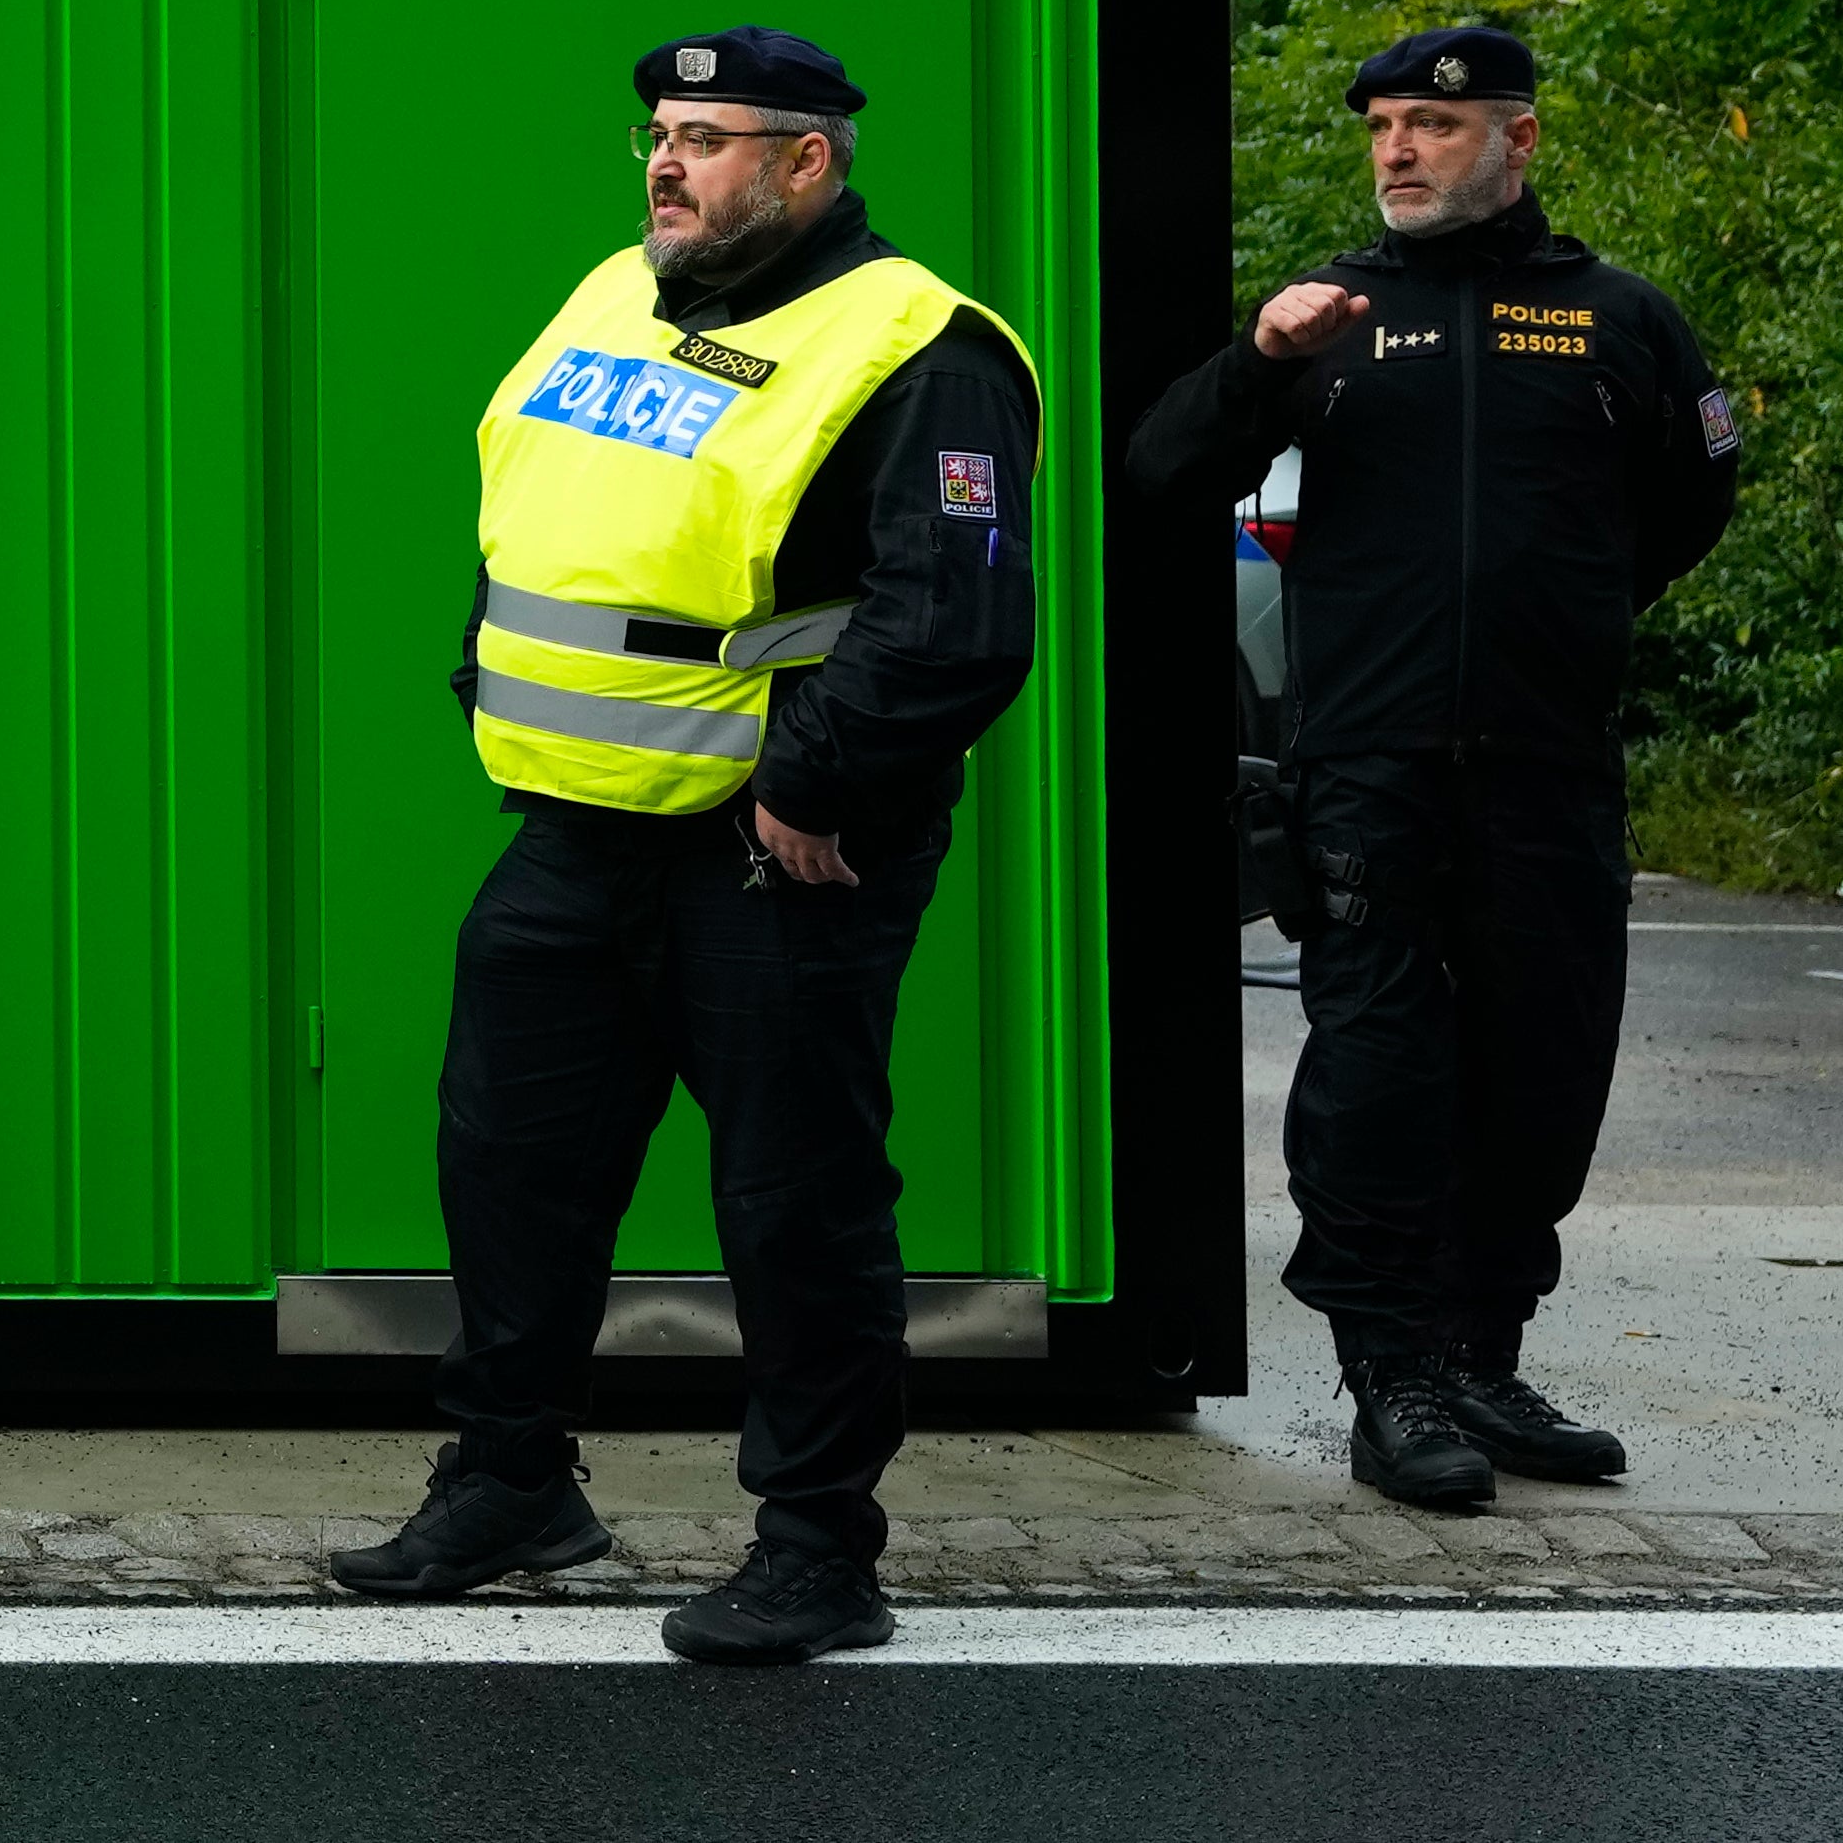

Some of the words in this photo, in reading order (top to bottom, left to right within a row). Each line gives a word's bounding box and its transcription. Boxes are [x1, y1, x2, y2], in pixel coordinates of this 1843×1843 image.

[1492, 303, 1594, 326] POLICIE
[1498, 332, 1587, 355] 235023
[678, 337, 768, 382] 302880
[530, 360, 722, 442] POLICIE
[945, 503, 992, 514] POLICIE
